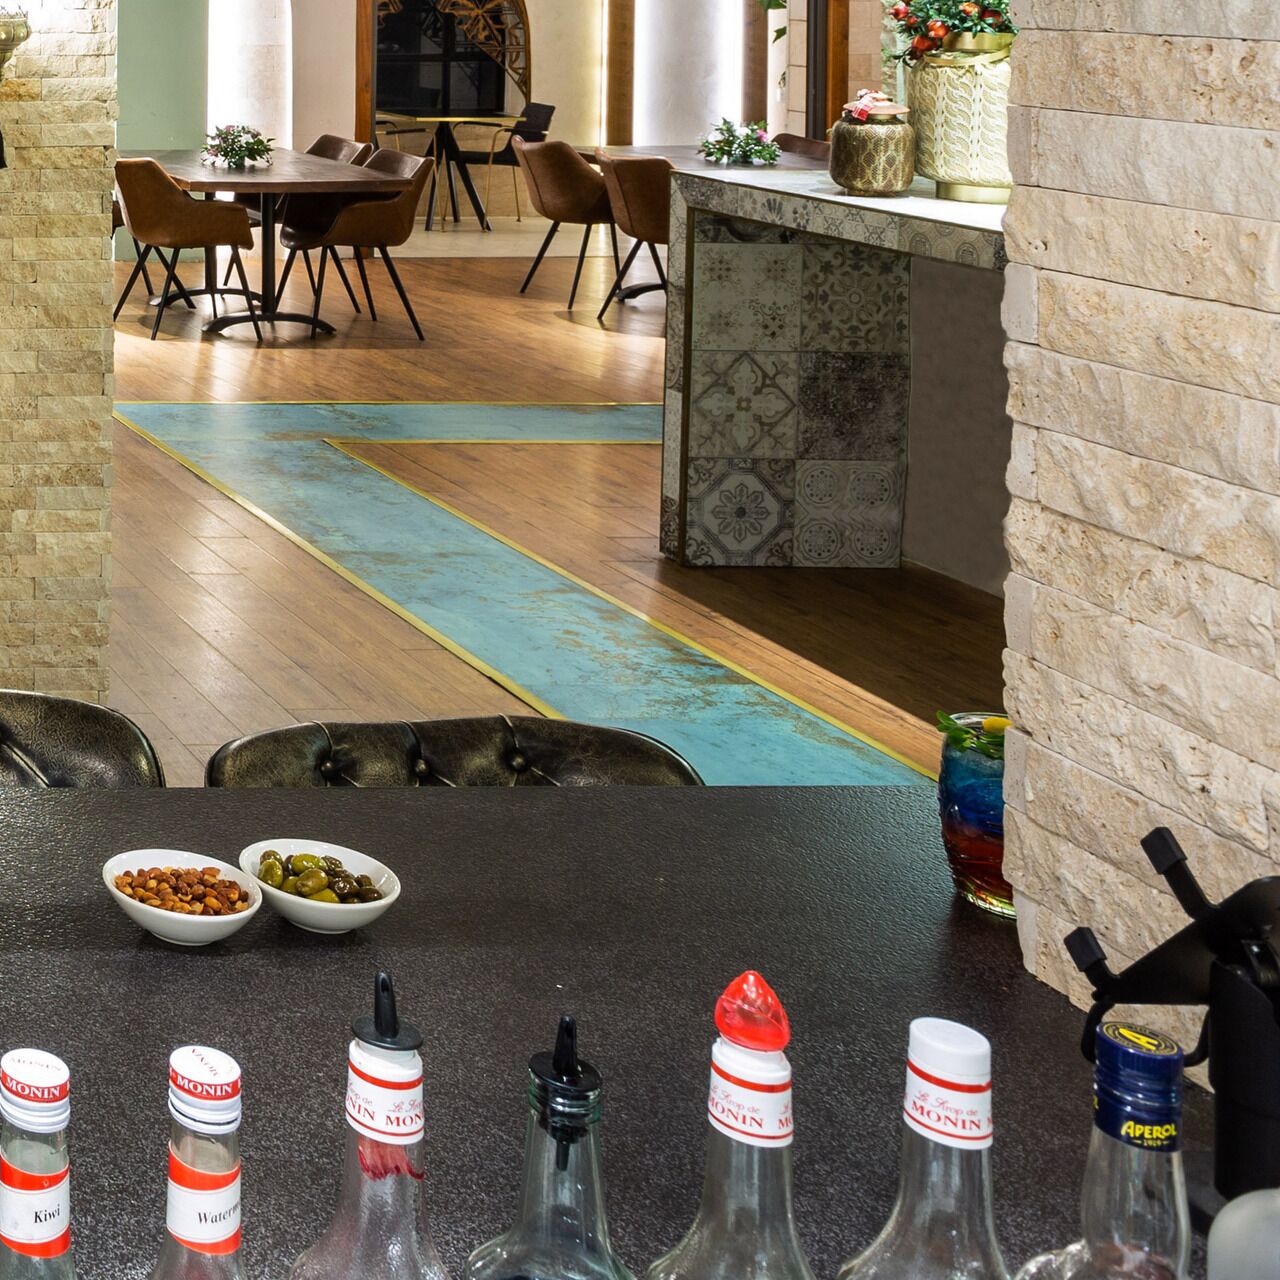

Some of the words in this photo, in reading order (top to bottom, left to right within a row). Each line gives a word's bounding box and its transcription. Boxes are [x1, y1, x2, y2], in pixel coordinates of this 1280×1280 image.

[6, 1076, 60, 1099] MONIN
[177, 1076, 233, 1097] MONIN
[746, 1105, 761, 1115] de
[915, 1089, 931, 1103] Le
[932, 1093, 964, 1118] Sirop
[965, 1107, 979, 1117] de
[911, 1101, 982, 1131] MONIN
[1120, 1120, 1178, 1140] APEROL
[33, 1203, 61, 1224] Kiwi
